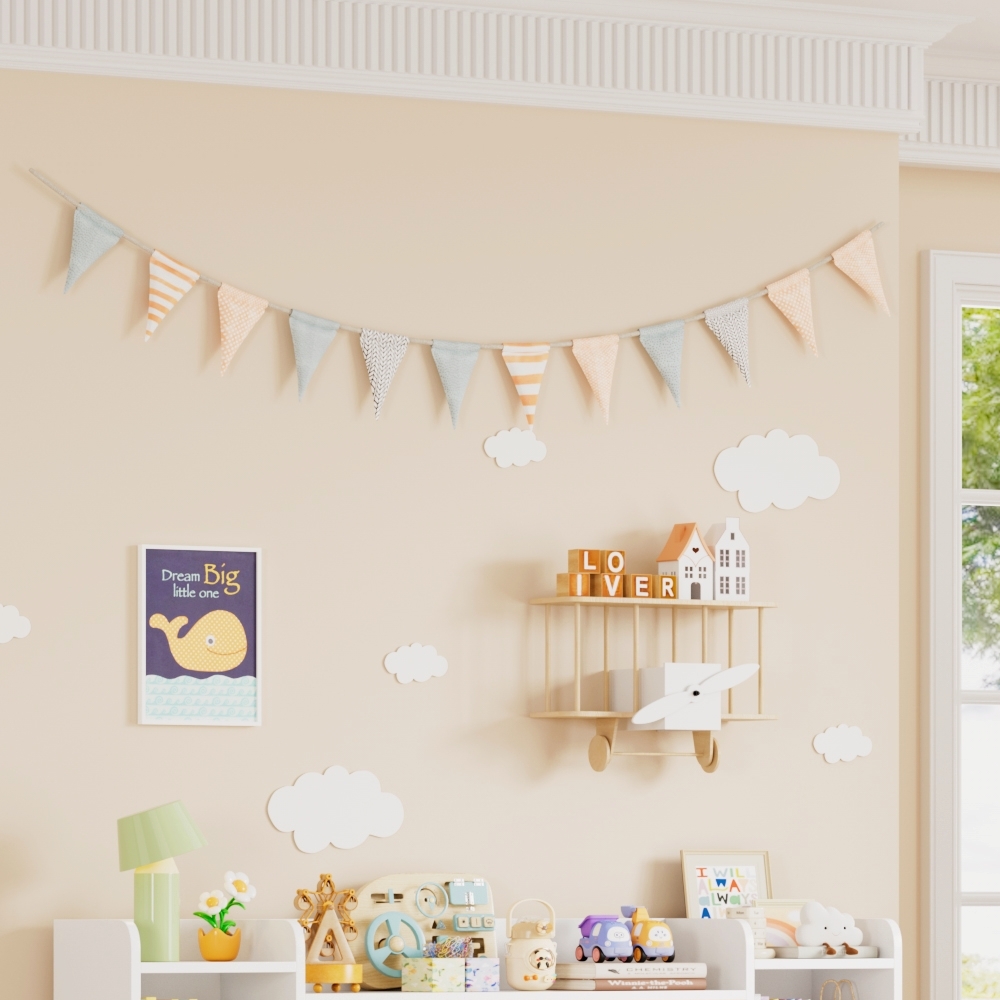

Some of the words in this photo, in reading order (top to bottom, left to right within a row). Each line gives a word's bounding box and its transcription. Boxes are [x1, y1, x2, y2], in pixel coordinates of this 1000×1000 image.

[161, 569, 200, 582] Dream
[203, 563, 240, 595] Big
[173, 583, 196, 598] little
[198, 589, 219, 598] one
[696, 867, 708, 877] I
